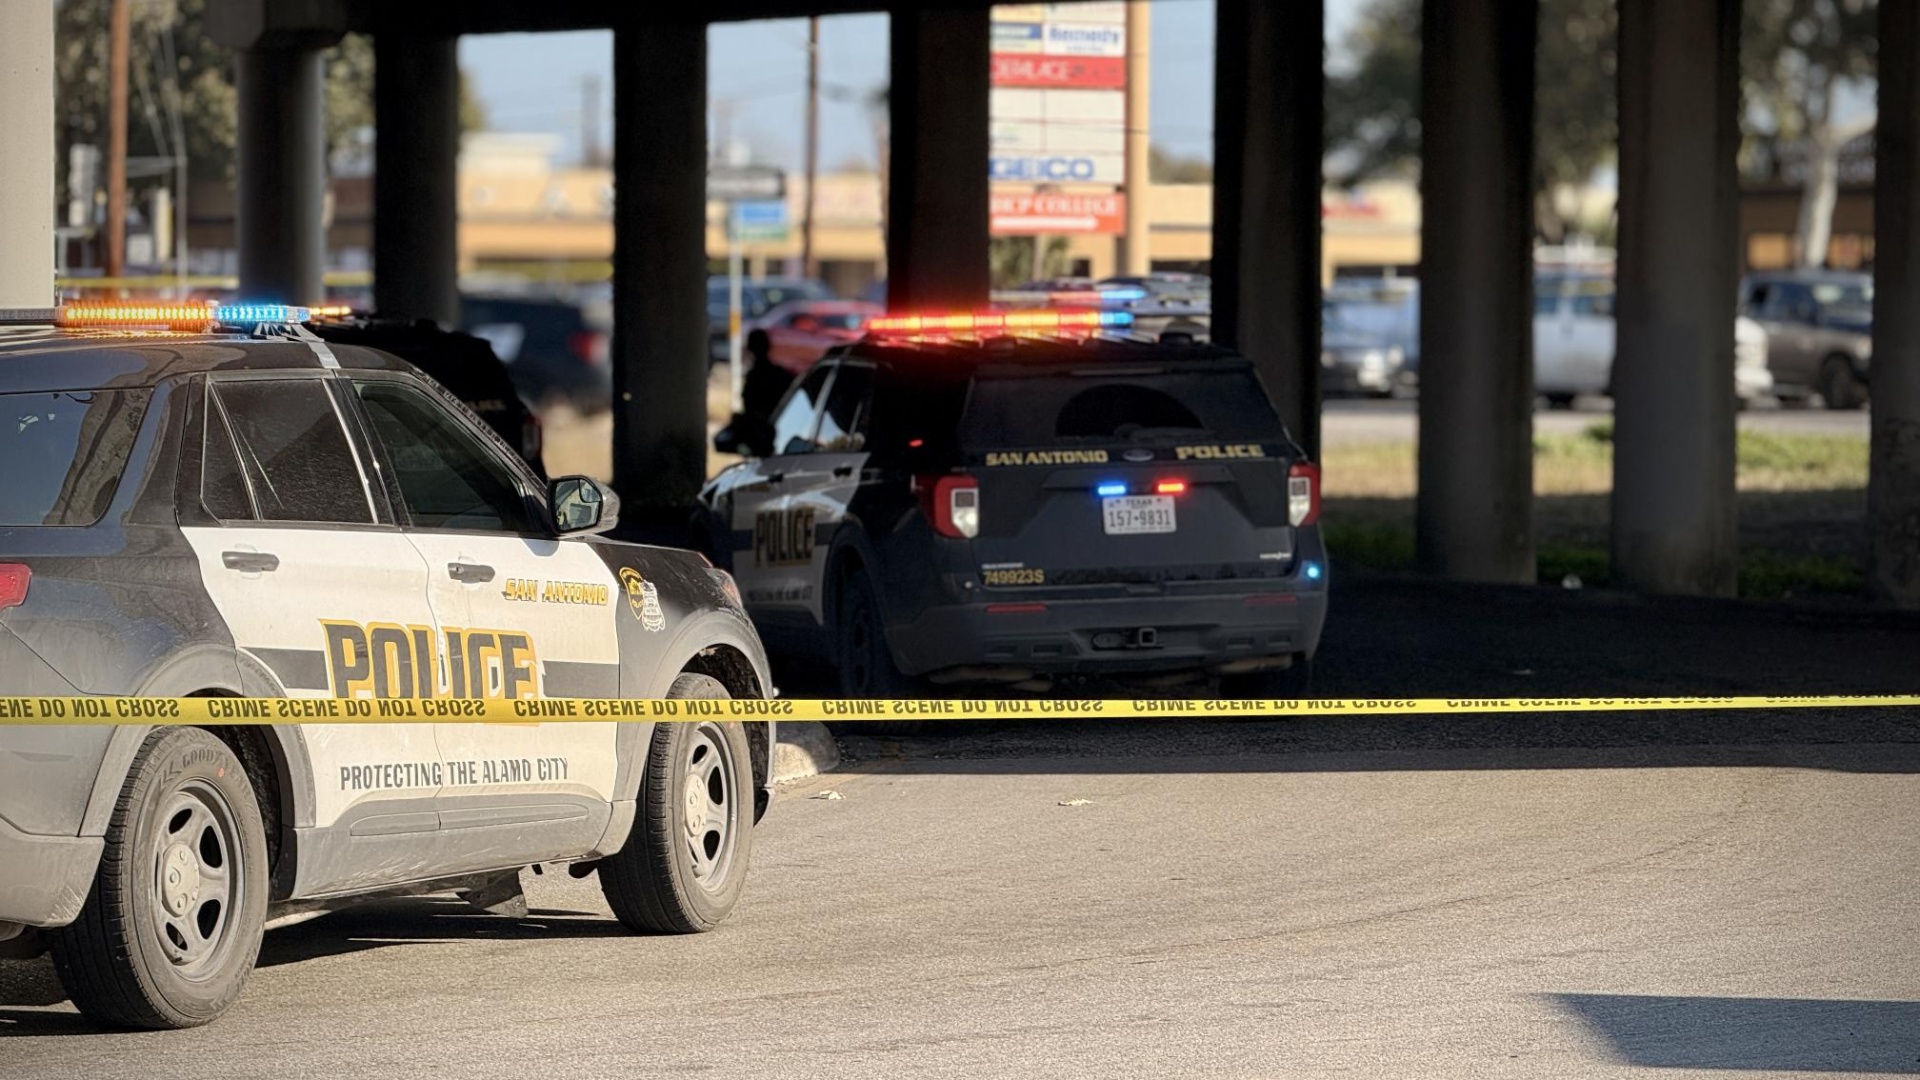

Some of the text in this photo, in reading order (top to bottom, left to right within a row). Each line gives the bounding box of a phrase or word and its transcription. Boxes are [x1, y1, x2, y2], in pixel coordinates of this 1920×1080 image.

[988, 157, 1095, 180] GEICO
[1033, 197, 1117, 216] COLLEGE
[985, 445, 1265, 466] SAN ANTONIO POLICE
[755, 506, 816, 566] POLICE
[983, 569, 1045, 585] 749923S
[504, 578, 609, 606] SAN ANTONIO
[319, 618, 540, 703] POLICE
[340, 756, 569, 791] PROTECTING THE ALAMO CITY
